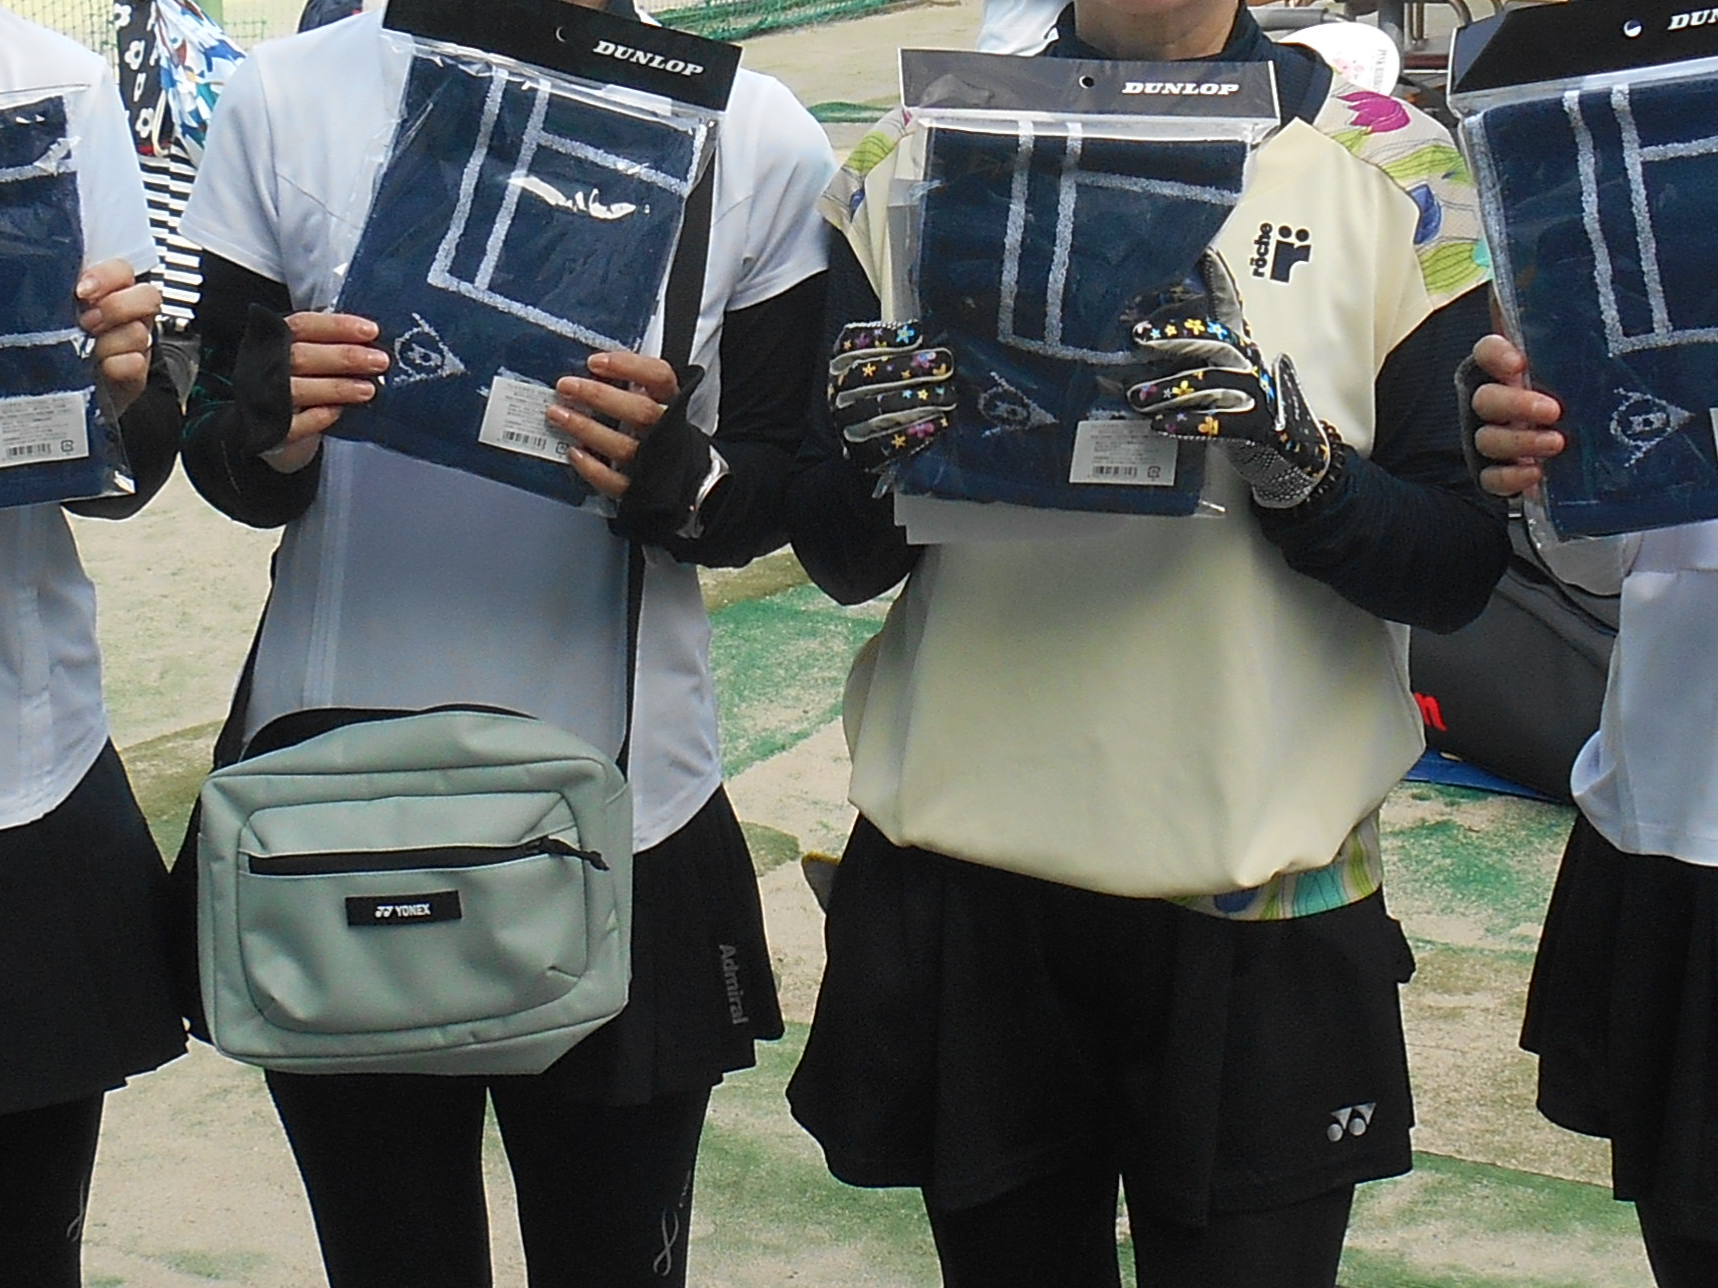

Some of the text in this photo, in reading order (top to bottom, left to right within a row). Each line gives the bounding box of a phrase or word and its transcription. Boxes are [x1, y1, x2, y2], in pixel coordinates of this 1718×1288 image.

[592, 39, 705, 77] DUNLOP
[1121, 81, 1240, 96] DUNLOP
[1249, 222, 1273, 278] röche
[395, 903, 431, 918] YONEX
[719, 944, 749, 1024] Admiral
